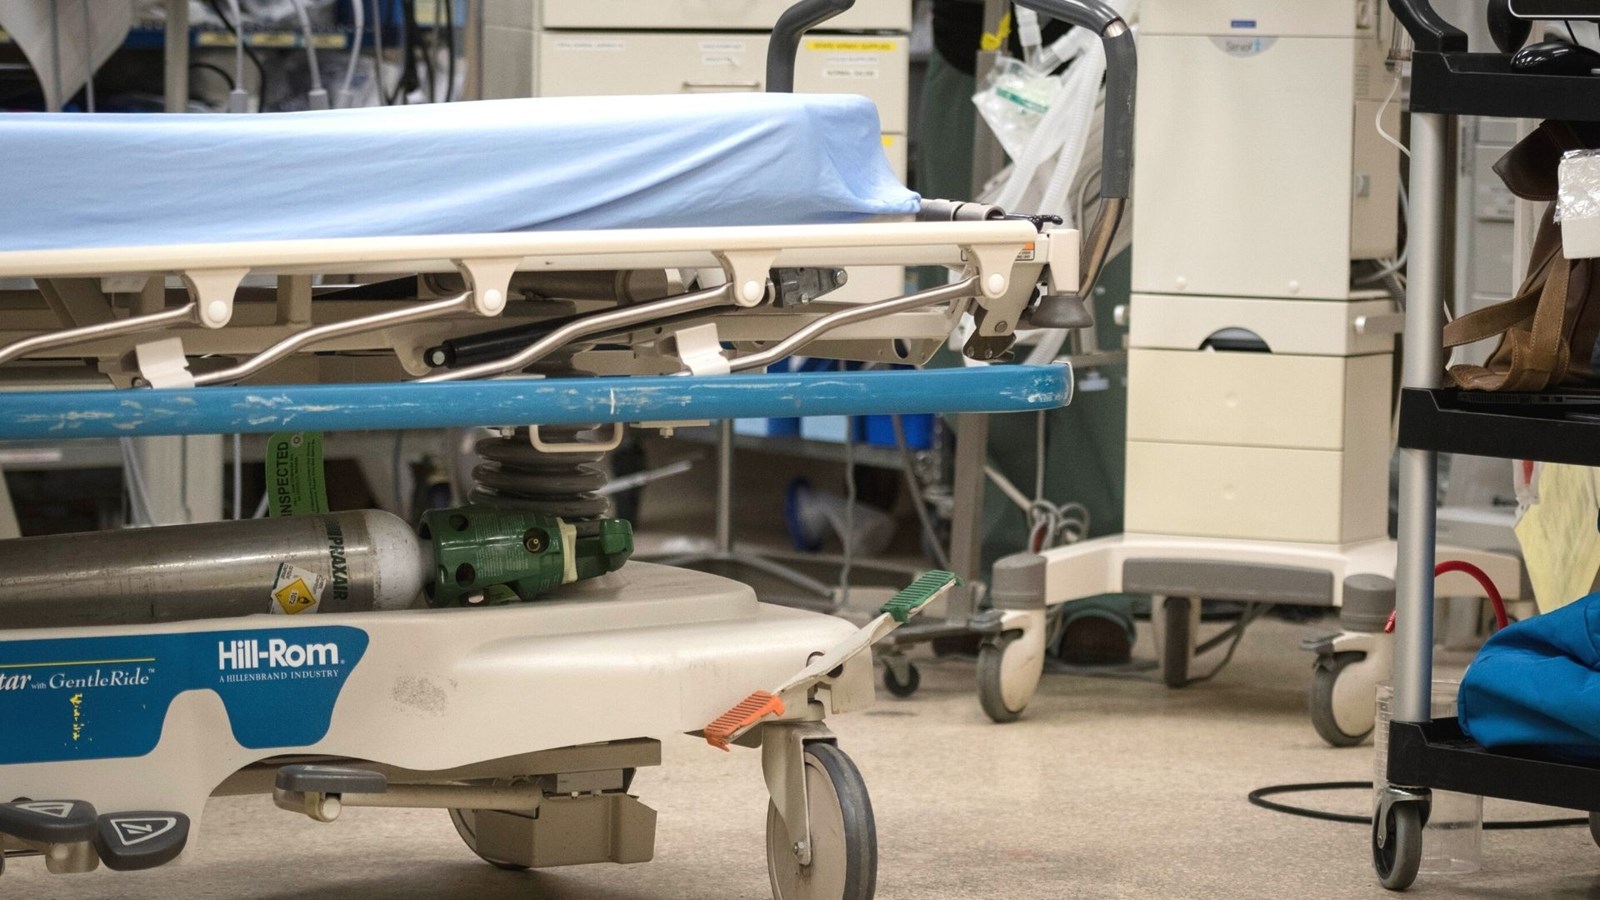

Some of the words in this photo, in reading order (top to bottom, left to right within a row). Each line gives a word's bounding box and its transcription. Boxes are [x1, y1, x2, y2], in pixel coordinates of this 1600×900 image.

[276, 441, 293, 517] INSPECTED
[328, 537, 349, 601] PRAXAIR
[218, 639, 339, 670] Hill-Rom
[31, 682, 47, 690] with
[219, 675, 225, 683] A
[226, 671, 288, 683] HILLENBRAND
[290, 669, 339, 680] INDUSTRY
